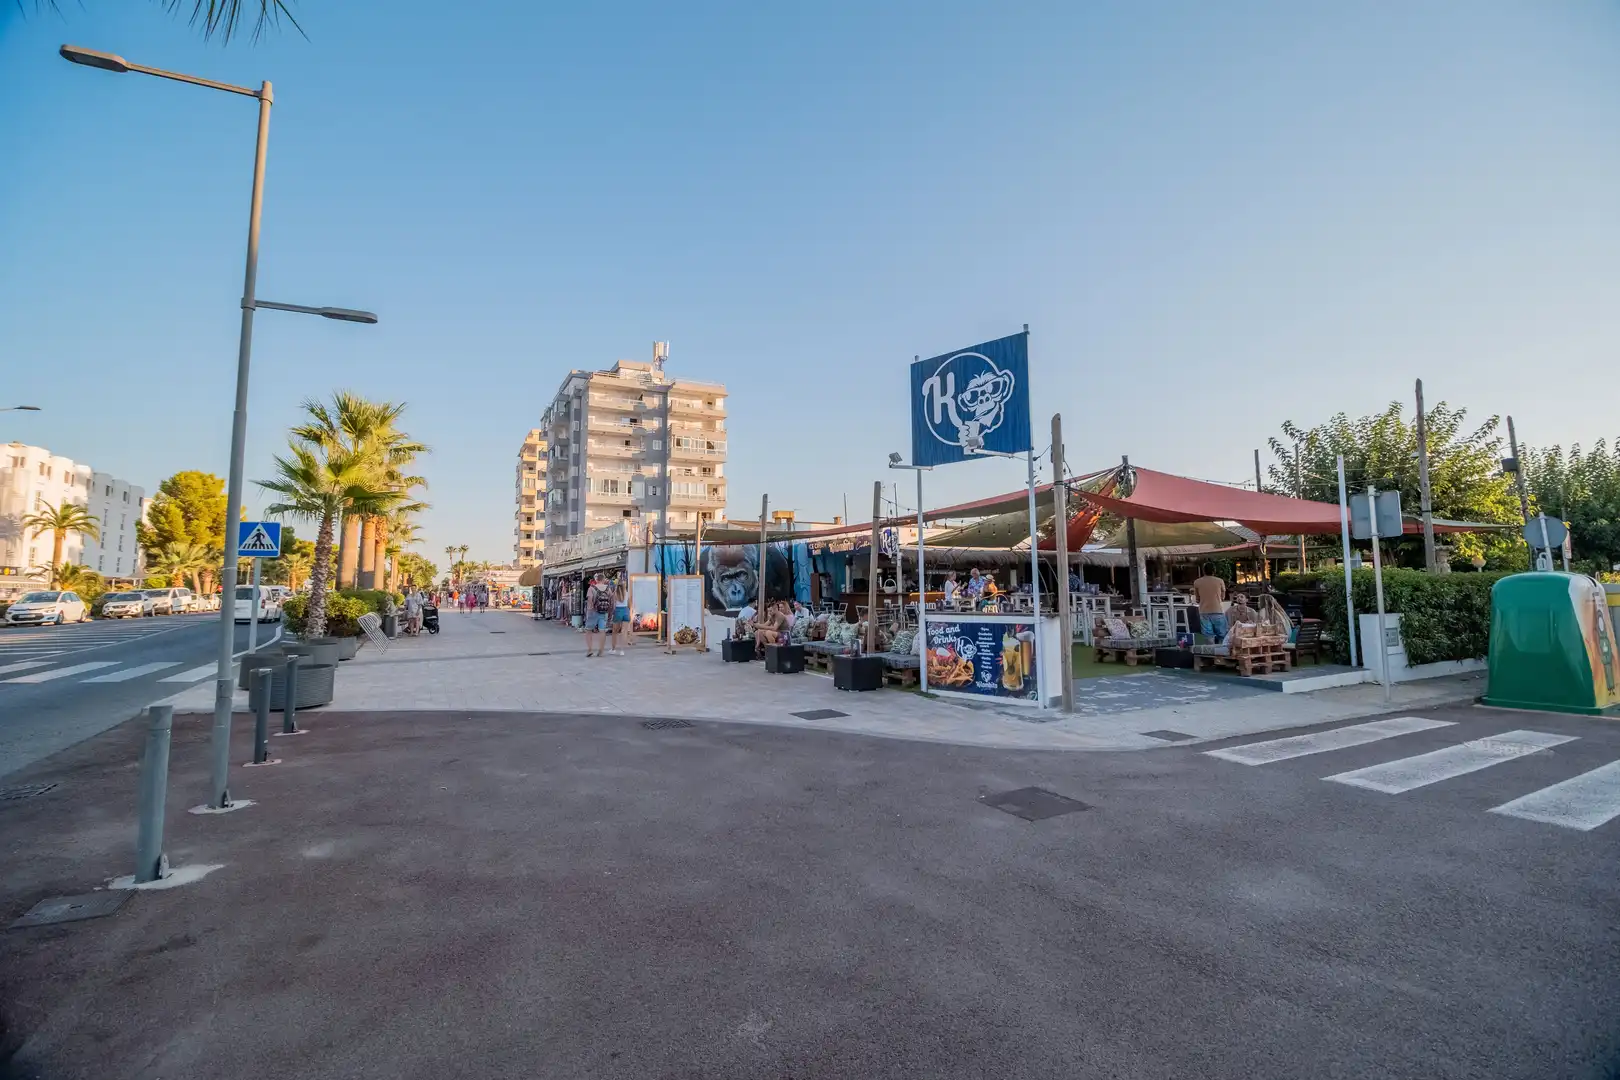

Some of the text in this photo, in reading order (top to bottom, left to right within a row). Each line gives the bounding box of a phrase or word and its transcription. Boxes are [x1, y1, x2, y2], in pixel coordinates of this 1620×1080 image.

[927, 624, 961, 636] Food and
[933, 634, 957, 645] Drinks
